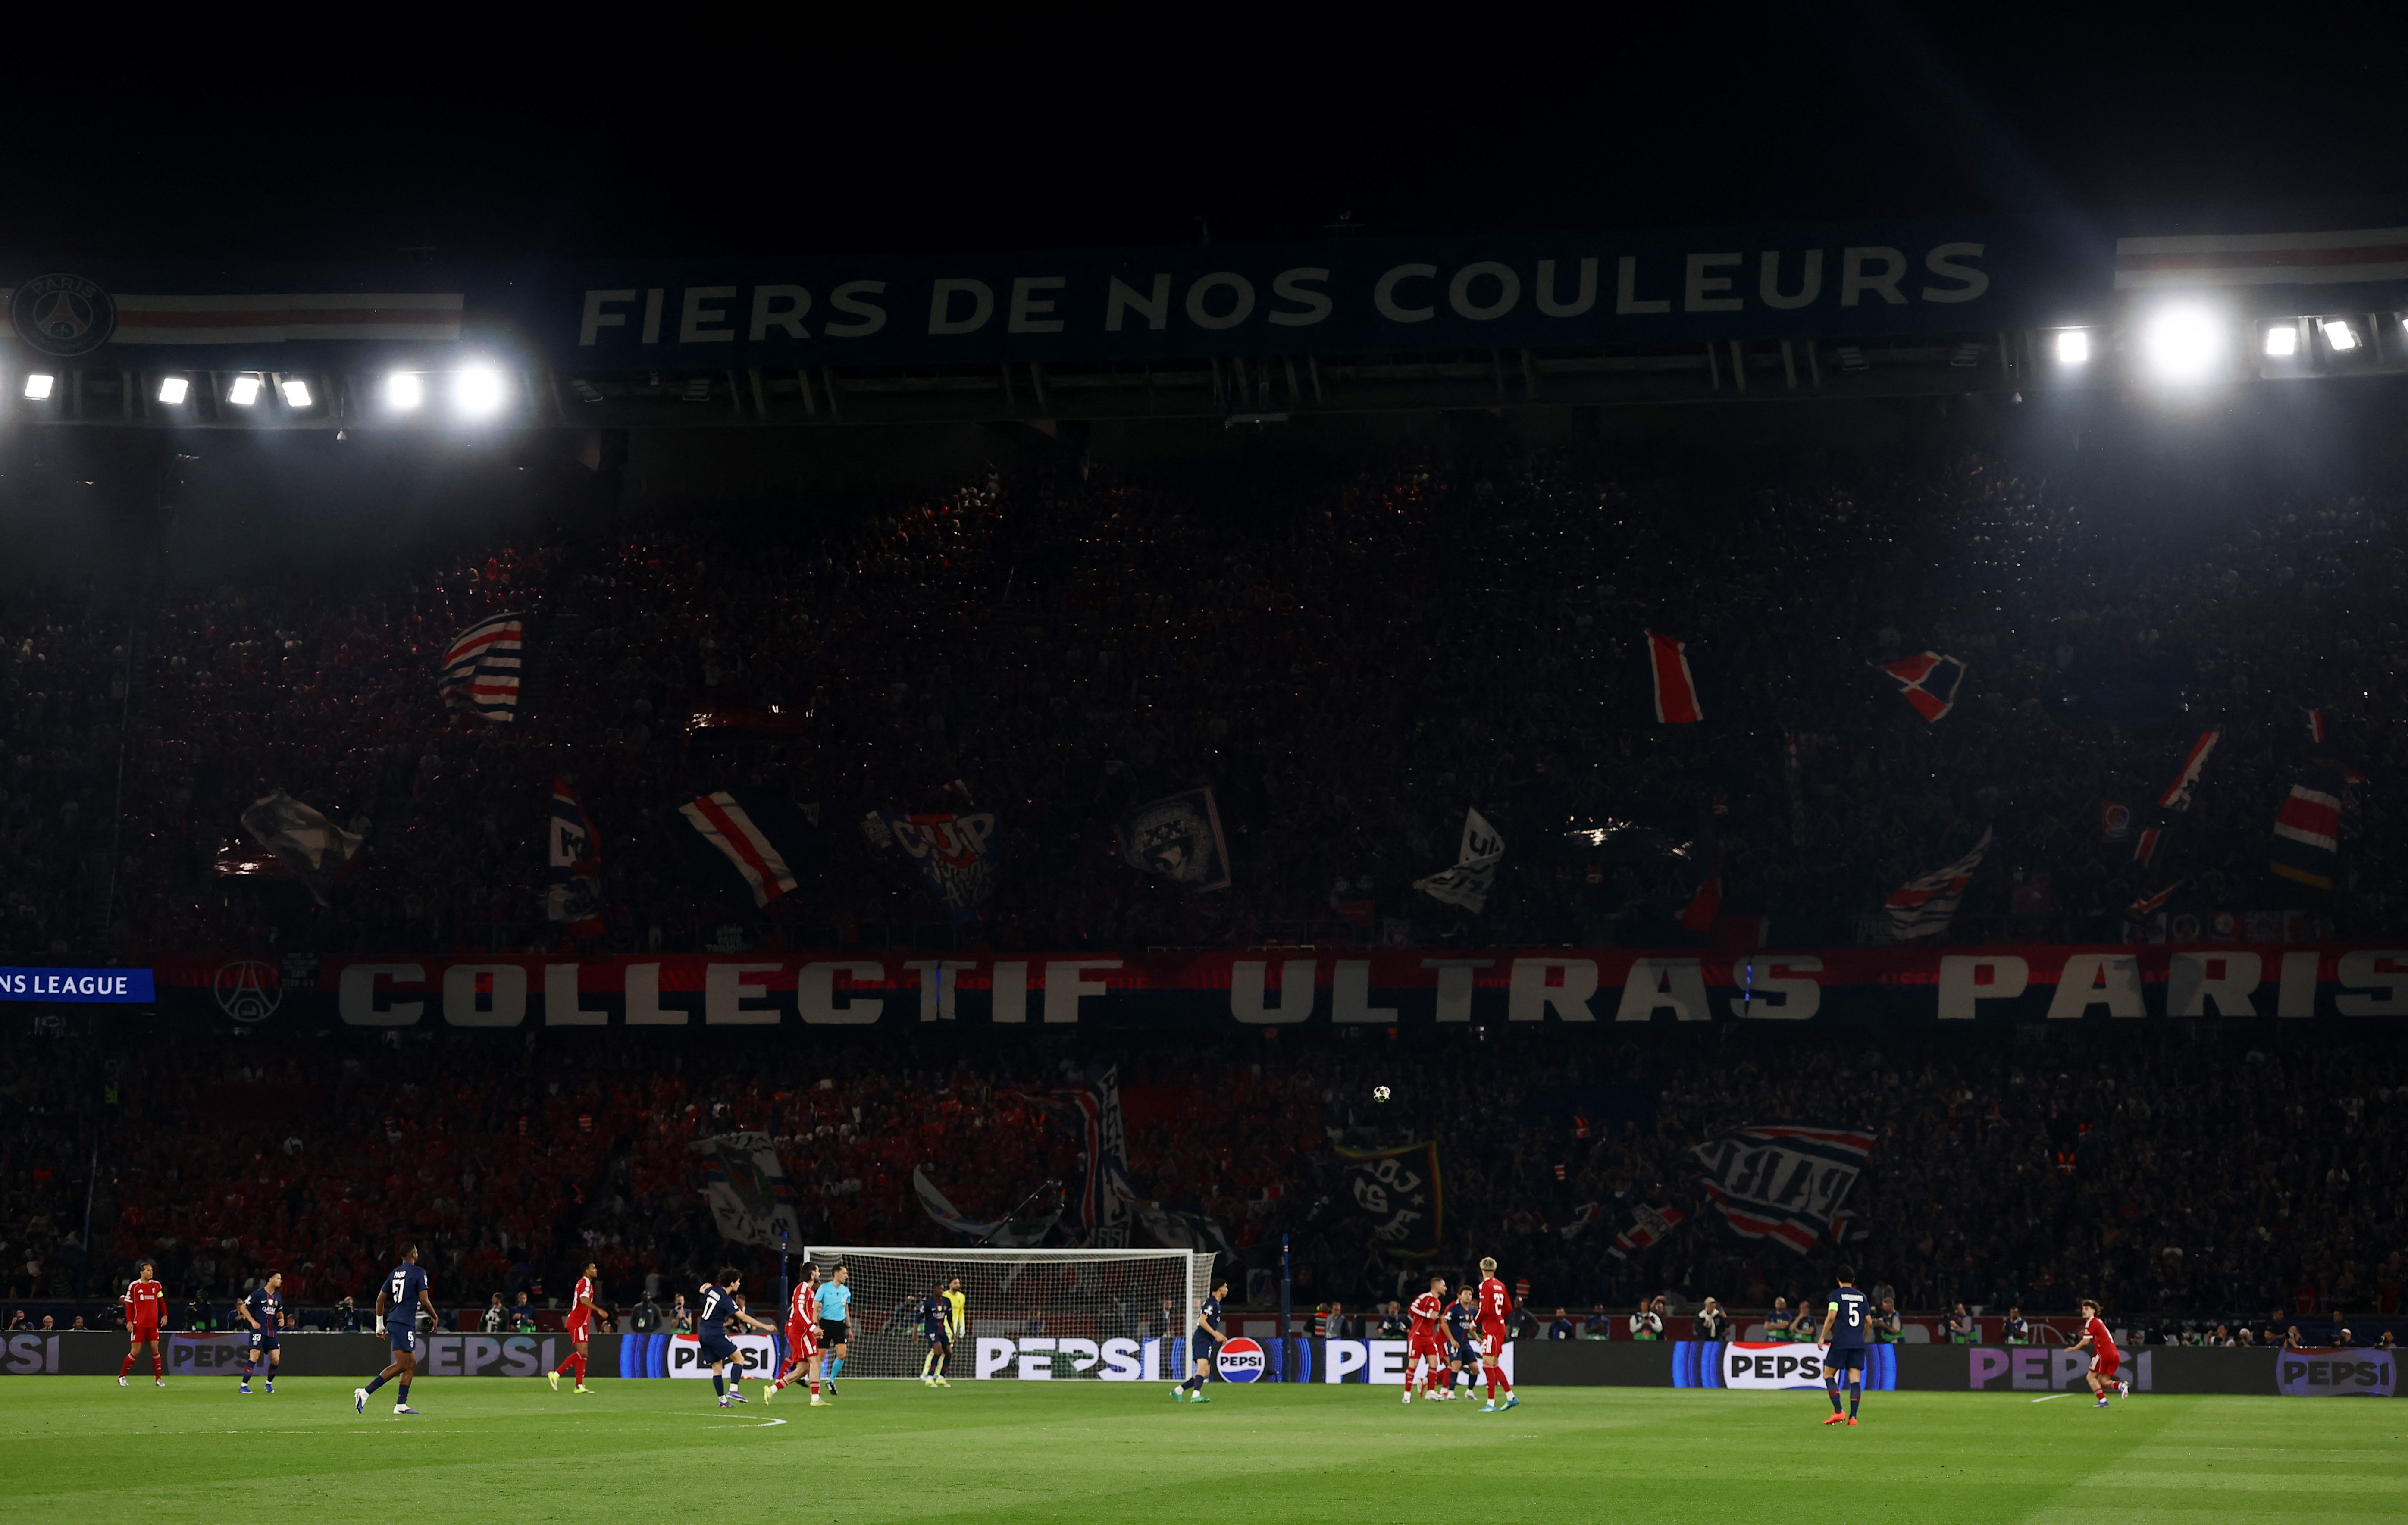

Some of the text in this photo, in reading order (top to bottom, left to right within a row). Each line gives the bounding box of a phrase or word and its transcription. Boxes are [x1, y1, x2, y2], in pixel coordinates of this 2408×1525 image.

[31, 277, 97, 298] PARIS
[579, 242, 1990, 345] FIERS DE NOS COULEURS
[34, 975, 127, 994] LEAGUE
[338, 950, 2408, 1027] COLLECTIF ULTRAS PARIS
[392, 1278, 405, 1303] 51
[701, 1296, 717, 1320] 17
[1848, 1302, 1860, 1327] 5
[407, 1331, 415, 1342] 5
[0, 1334, 59, 1375] SI
[1220, 1356, 1262, 1366] PEPSI
[1731, 1355, 1824, 1380] PEPS
[2283, 1361, 2389, 1386] PEPSI
